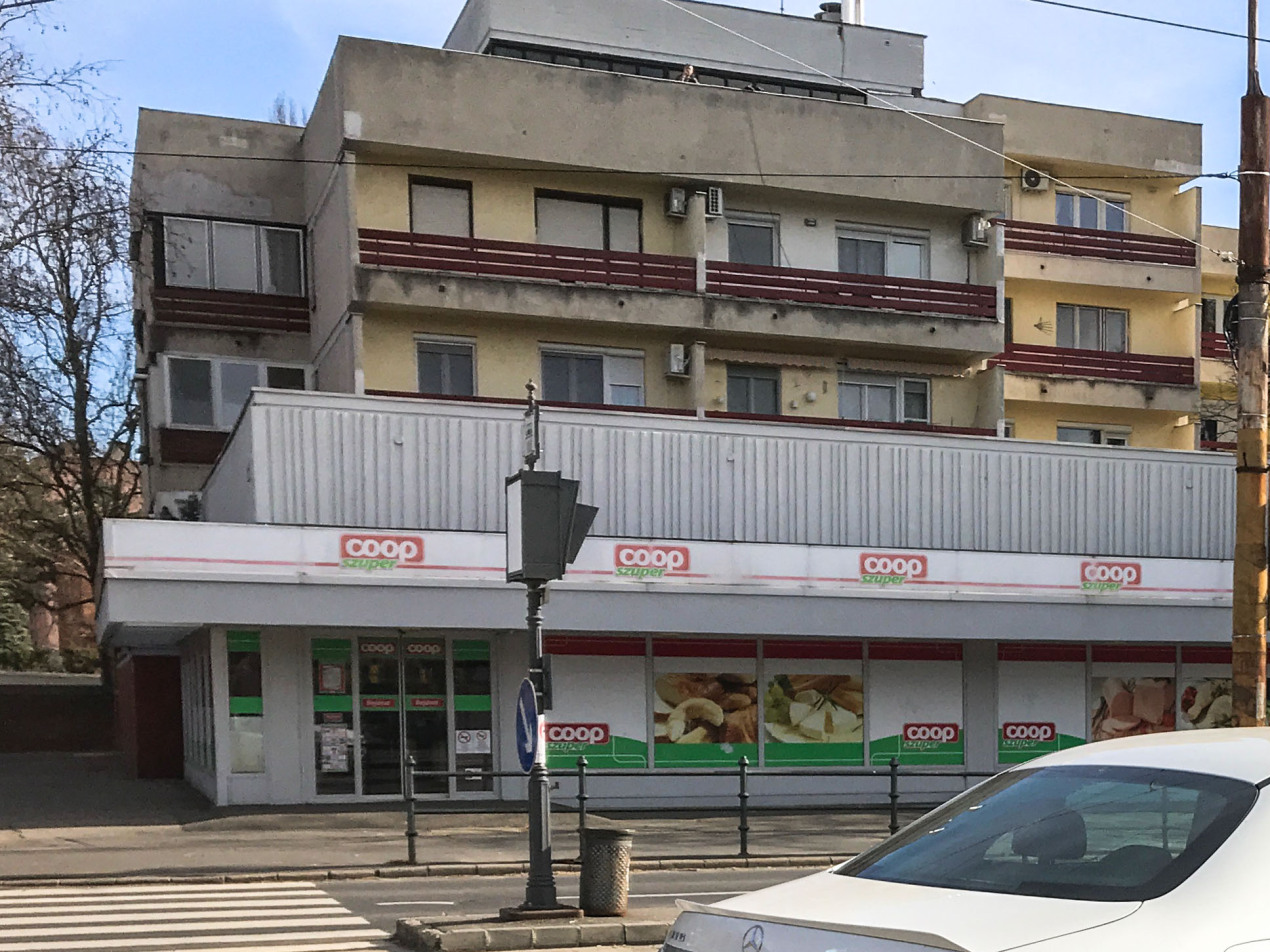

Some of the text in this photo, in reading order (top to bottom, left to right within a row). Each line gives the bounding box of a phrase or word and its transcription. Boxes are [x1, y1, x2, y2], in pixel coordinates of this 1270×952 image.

[345, 538, 418, 562] coop
[619, 548, 684, 570] coop
[616, 567, 665, 579] szuper
[864, 557, 923, 579] coop
[1084, 565, 1137, 585] coop
[861, 574, 906, 585] szuper
[1081, 581, 1122, 592] szuper
[360, 643, 395, 654] coop
[407, 644, 441, 655] coop
[549, 726, 604, 745] coop
[906, 726, 955, 743] coop
[1006, 725, 1052, 741] coop
